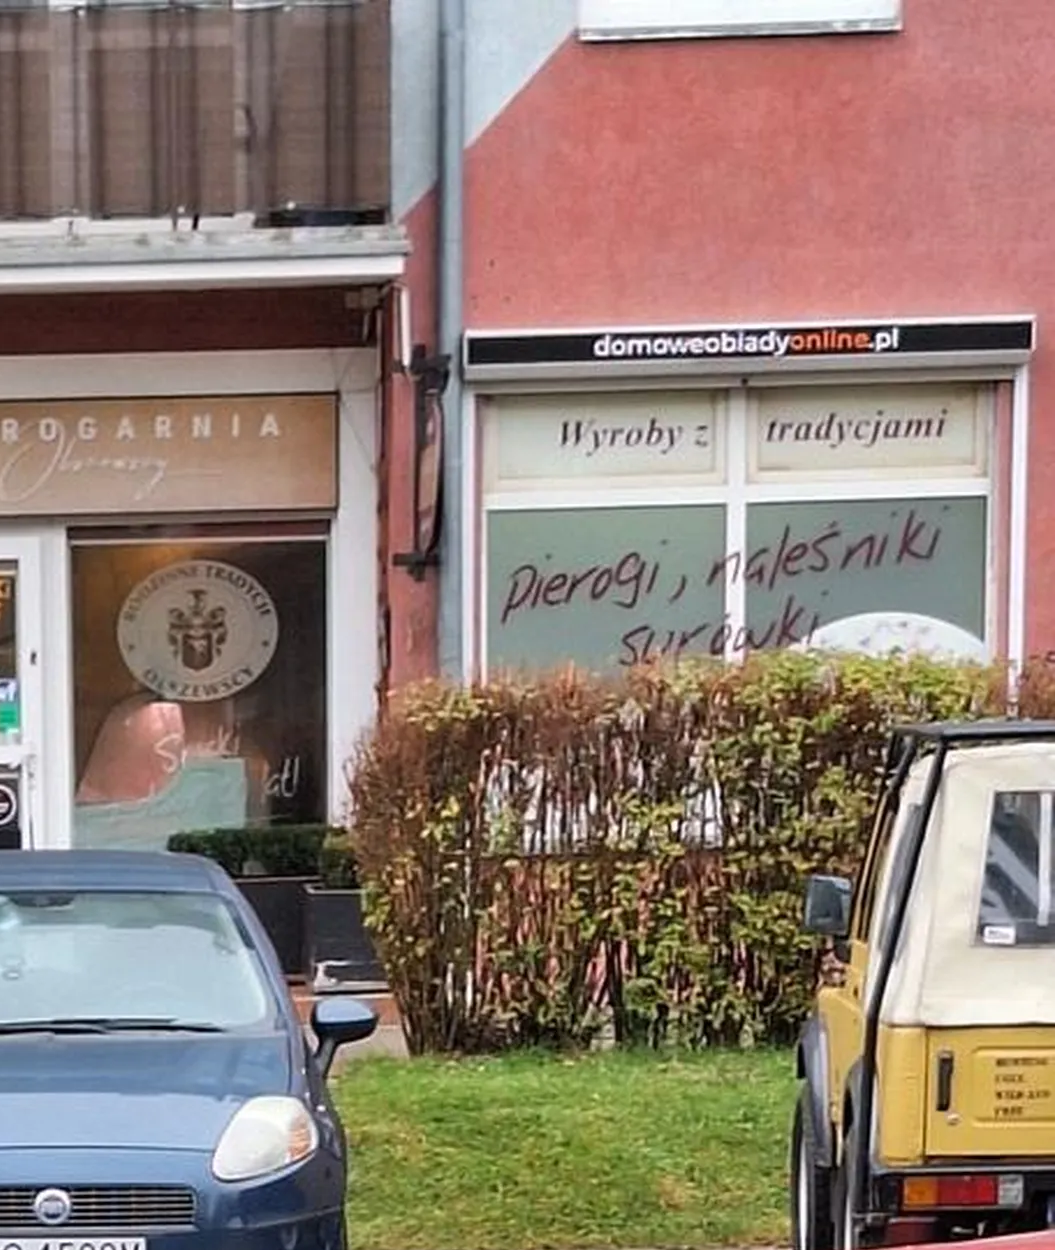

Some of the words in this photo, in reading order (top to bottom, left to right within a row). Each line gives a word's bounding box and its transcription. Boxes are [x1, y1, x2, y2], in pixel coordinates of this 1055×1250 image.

[594, 327, 899, 359] domoweobiadyonline.pl
[559, 417, 683, 456] Wyroby
[695, 425, 709, 448] z
[765, 408, 948, 449] tradycjami
[705, 504, 951, 592] naleśniki
[618, 590, 830, 666] surówki
